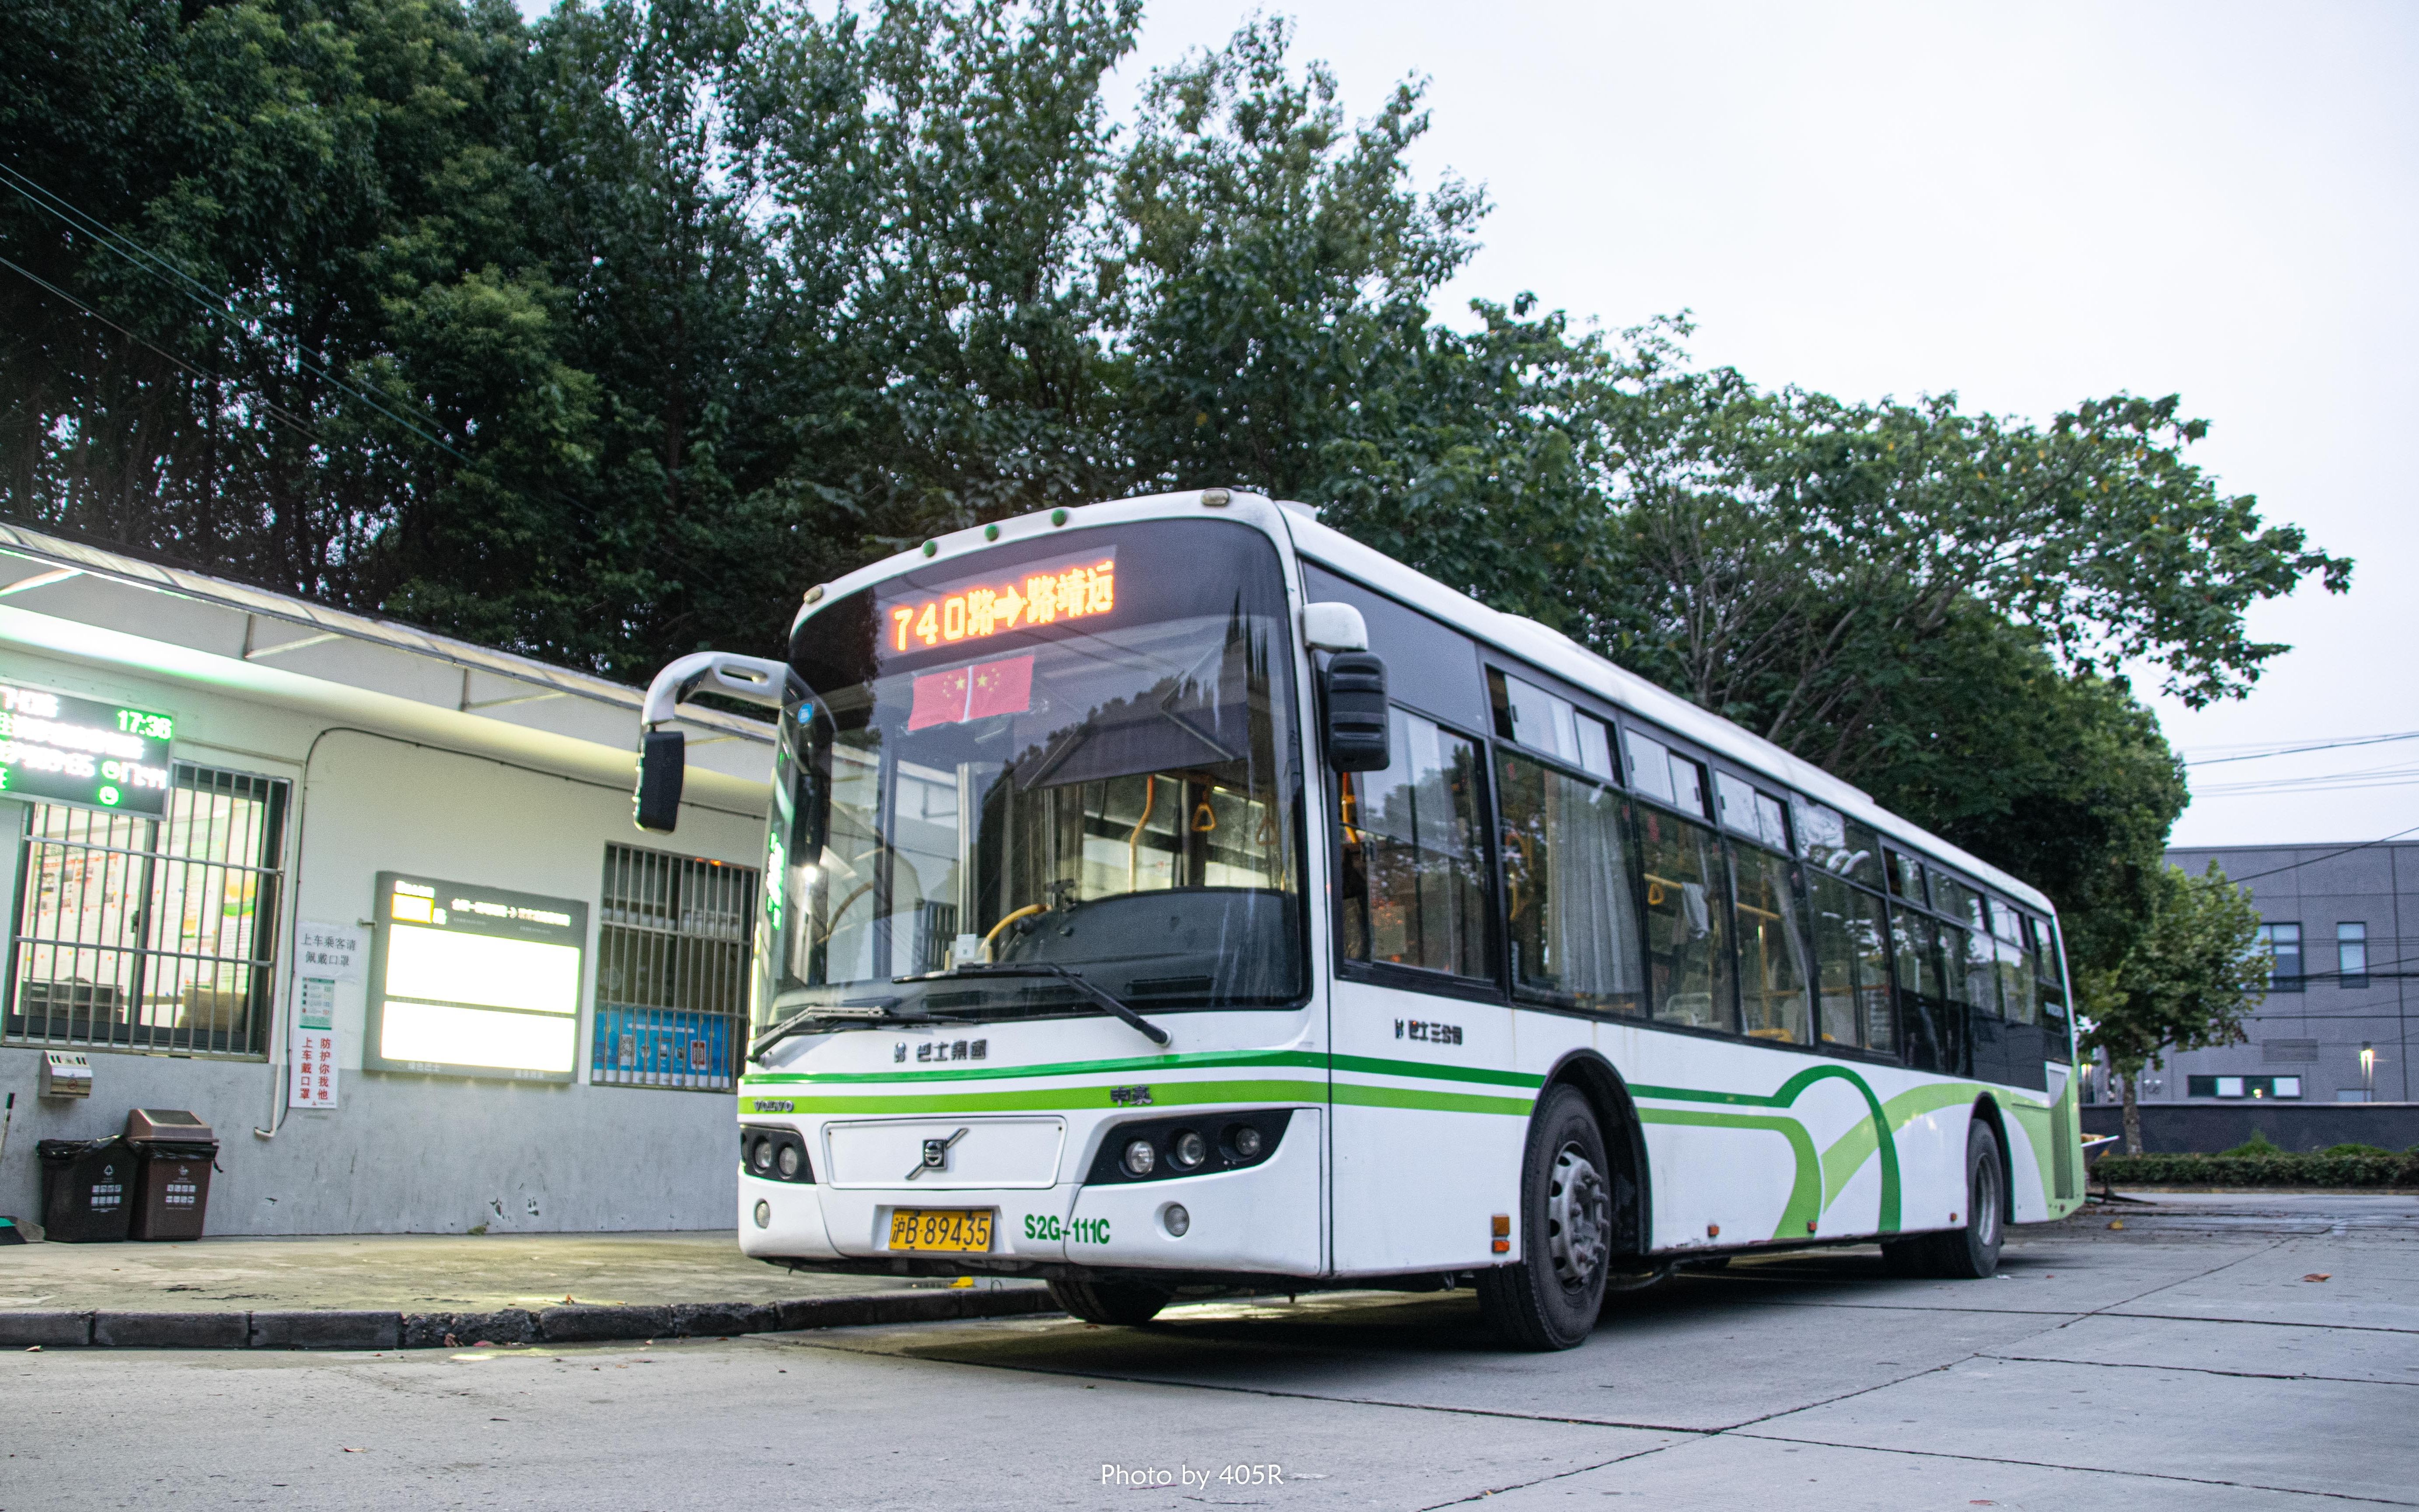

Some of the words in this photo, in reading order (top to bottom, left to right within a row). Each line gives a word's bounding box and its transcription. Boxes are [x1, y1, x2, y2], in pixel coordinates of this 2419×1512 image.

[301, 933, 356, 951] 上车乘客请
[306, 951, 349, 967] 佩戴口罩
[299, 1037, 313, 1100] 上车戴口罩
[318, 1038, 331, 1100] 防护你我他
[754, 1100, 794, 1113] VOLVO
[1024, 1214, 1110, 1245] S2G-111C
